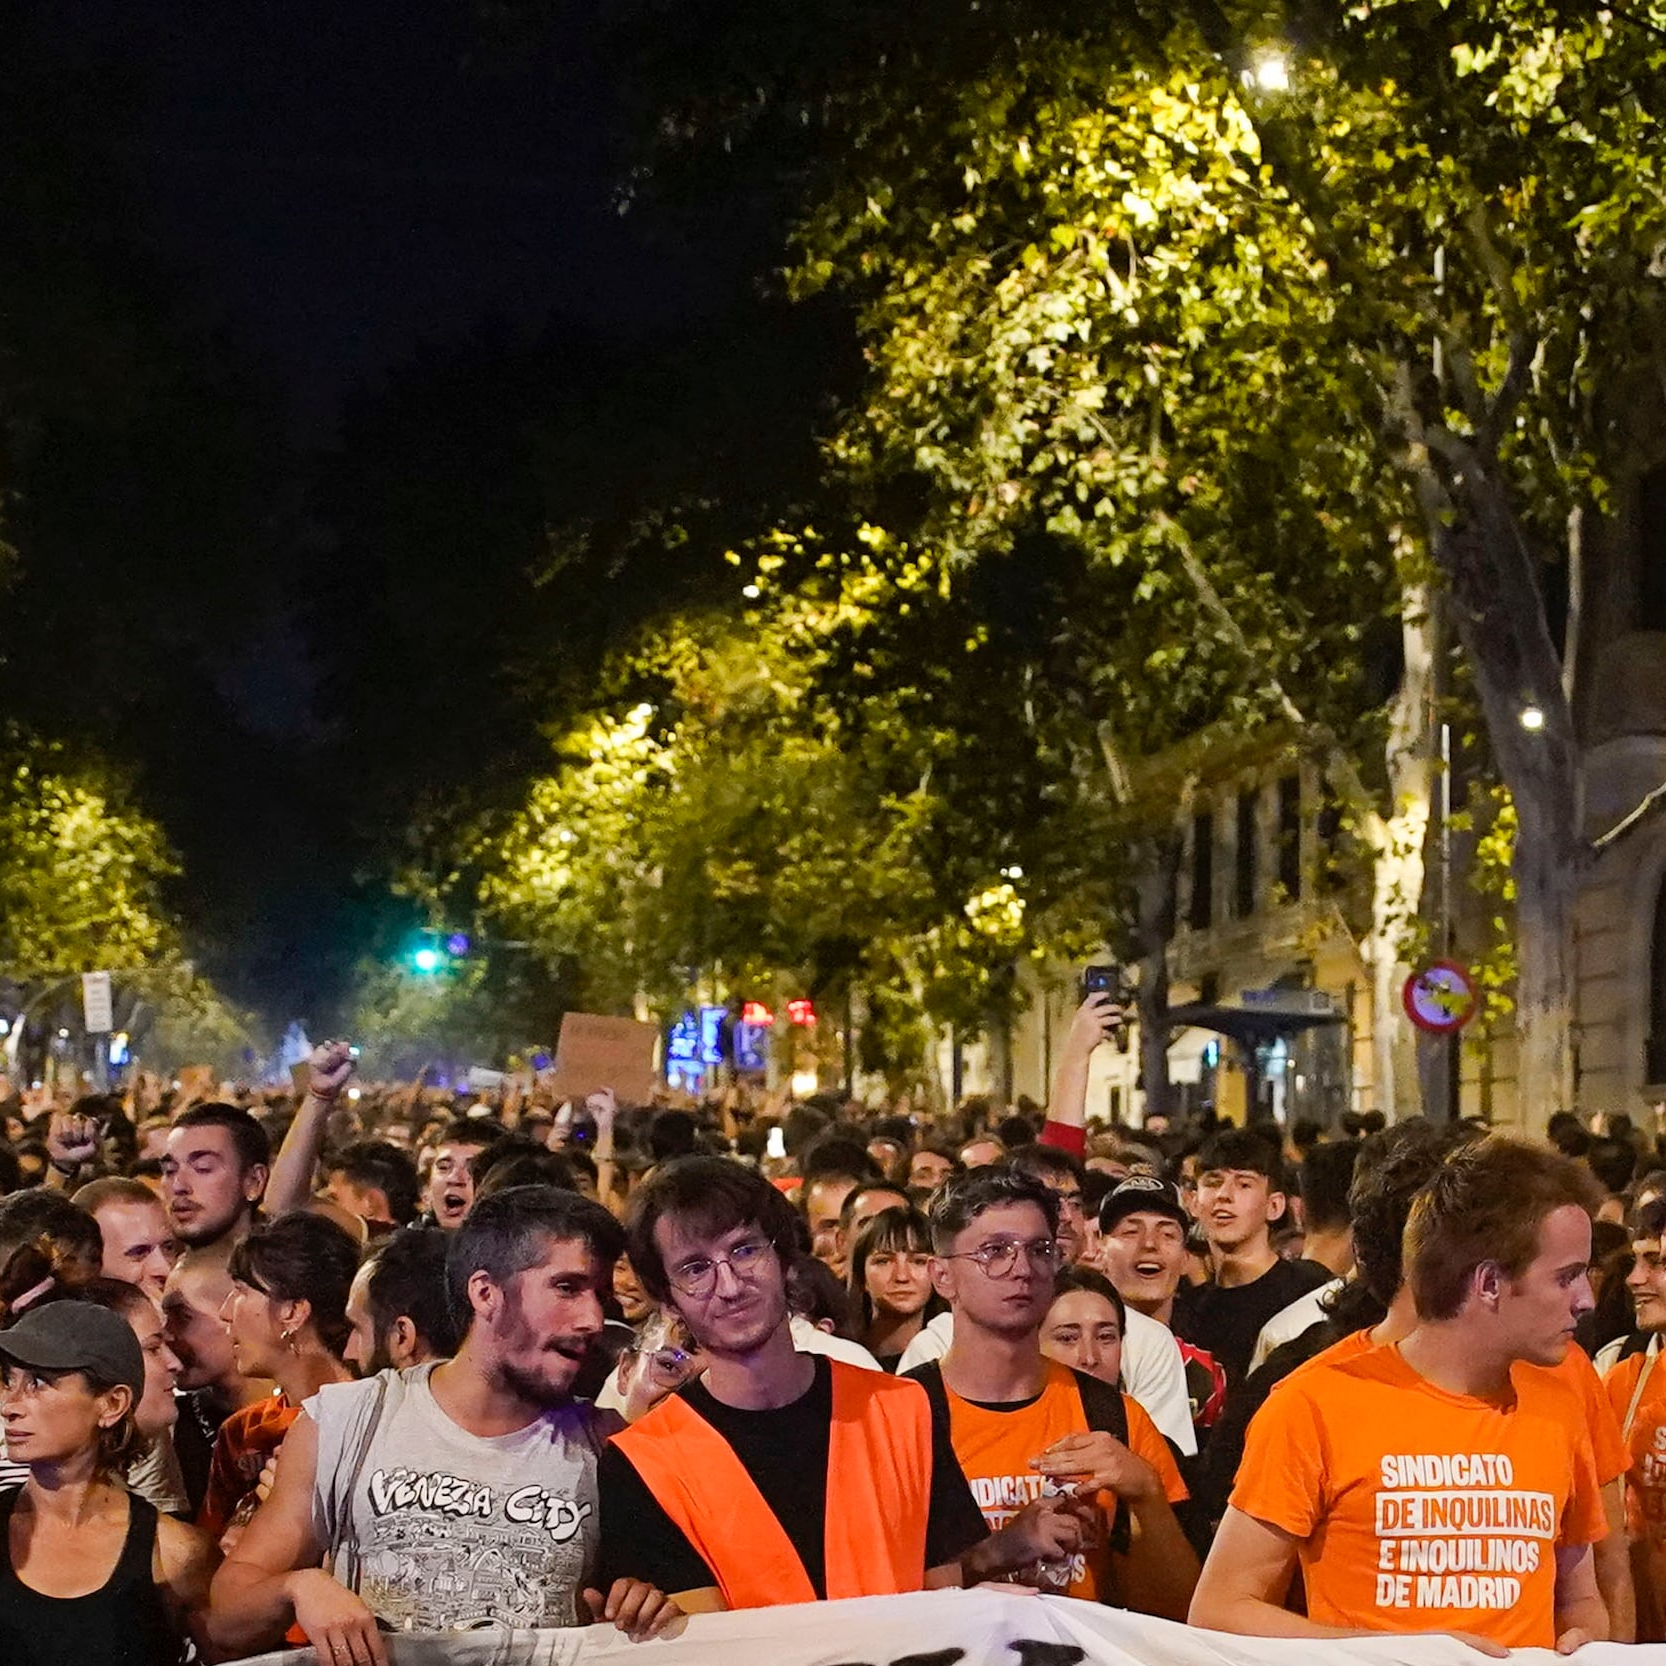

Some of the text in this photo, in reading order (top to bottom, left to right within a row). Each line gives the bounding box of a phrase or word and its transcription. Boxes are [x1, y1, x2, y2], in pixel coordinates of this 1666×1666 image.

[1380, 1454, 1514, 1489] SINDICATO
[1382, 1496, 1552, 1532] DE INQUILINAS
[1379, 1538, 1539, 1574] E INQUILINOS
[1376, 1573, 1521, 1610] DE MADRID
